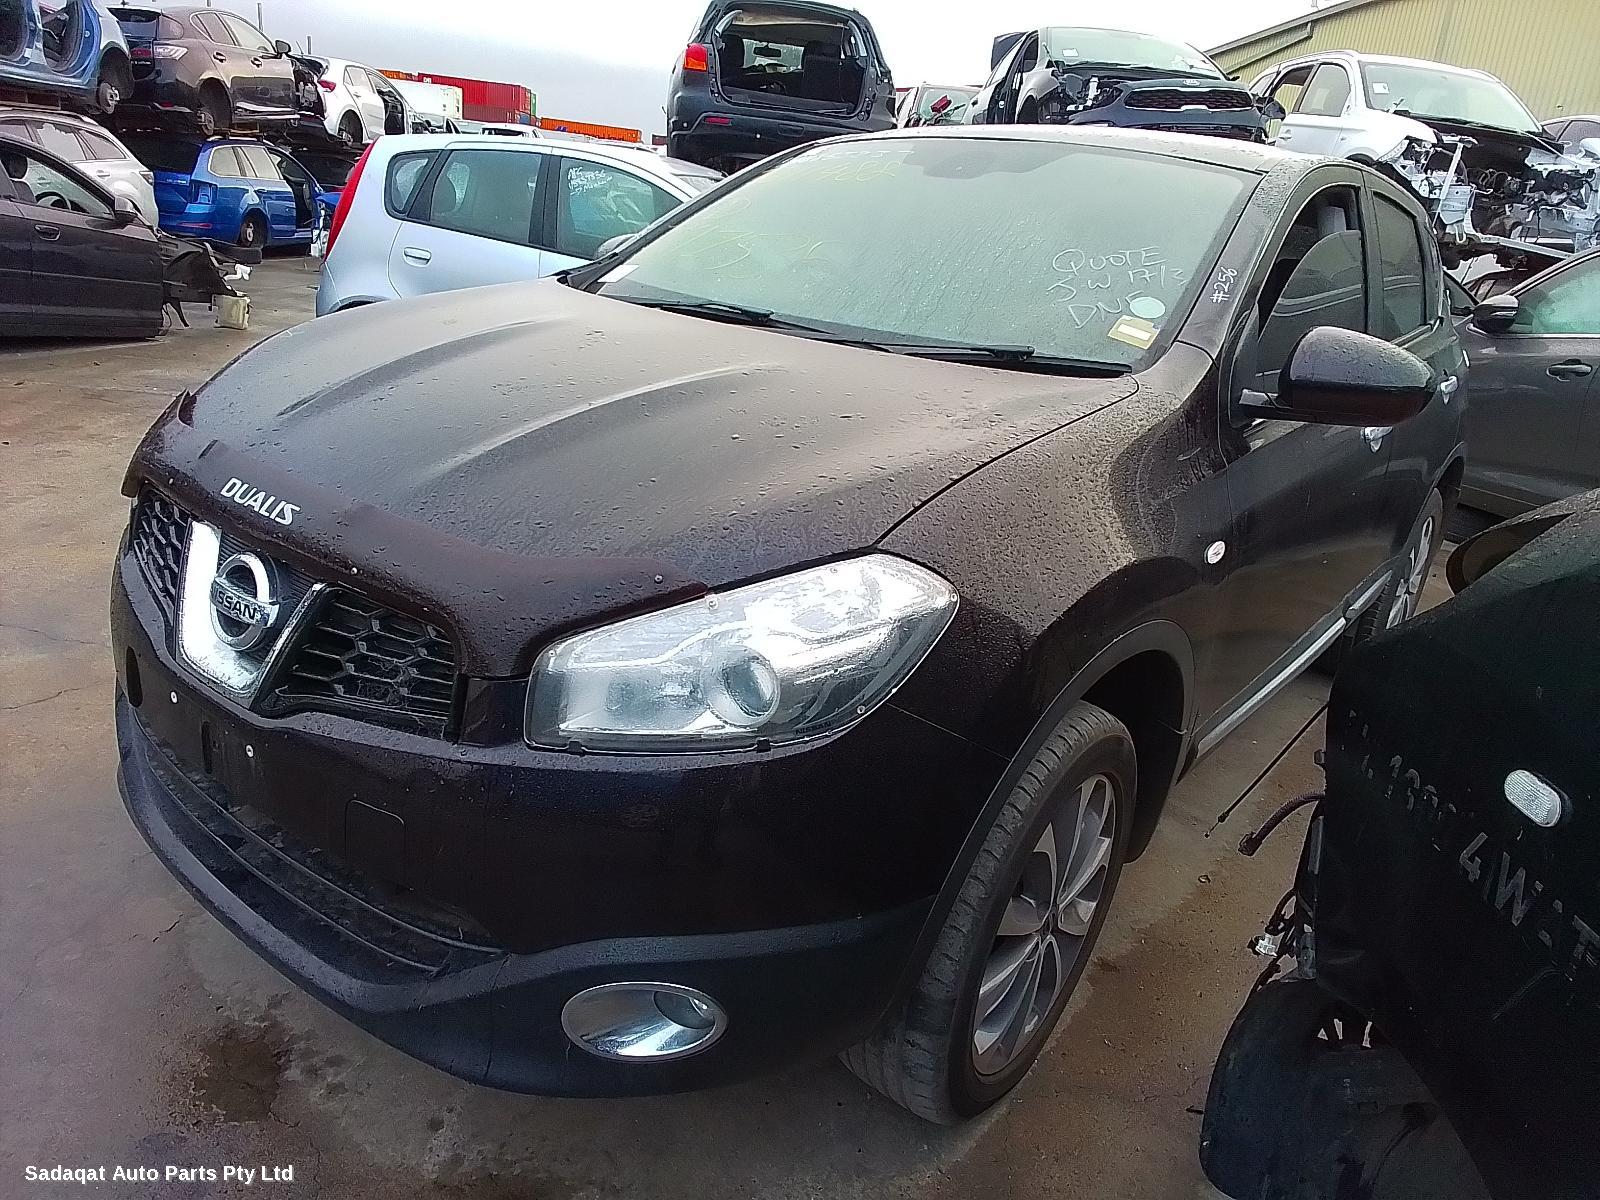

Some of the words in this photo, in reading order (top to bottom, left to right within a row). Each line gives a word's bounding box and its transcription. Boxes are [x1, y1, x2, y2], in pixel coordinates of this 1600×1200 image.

[1052, 246, 1167, 275] QUOTE
[1210, 266, 1238, 303] #256
[220, 477, 301, 525] DUALIS
